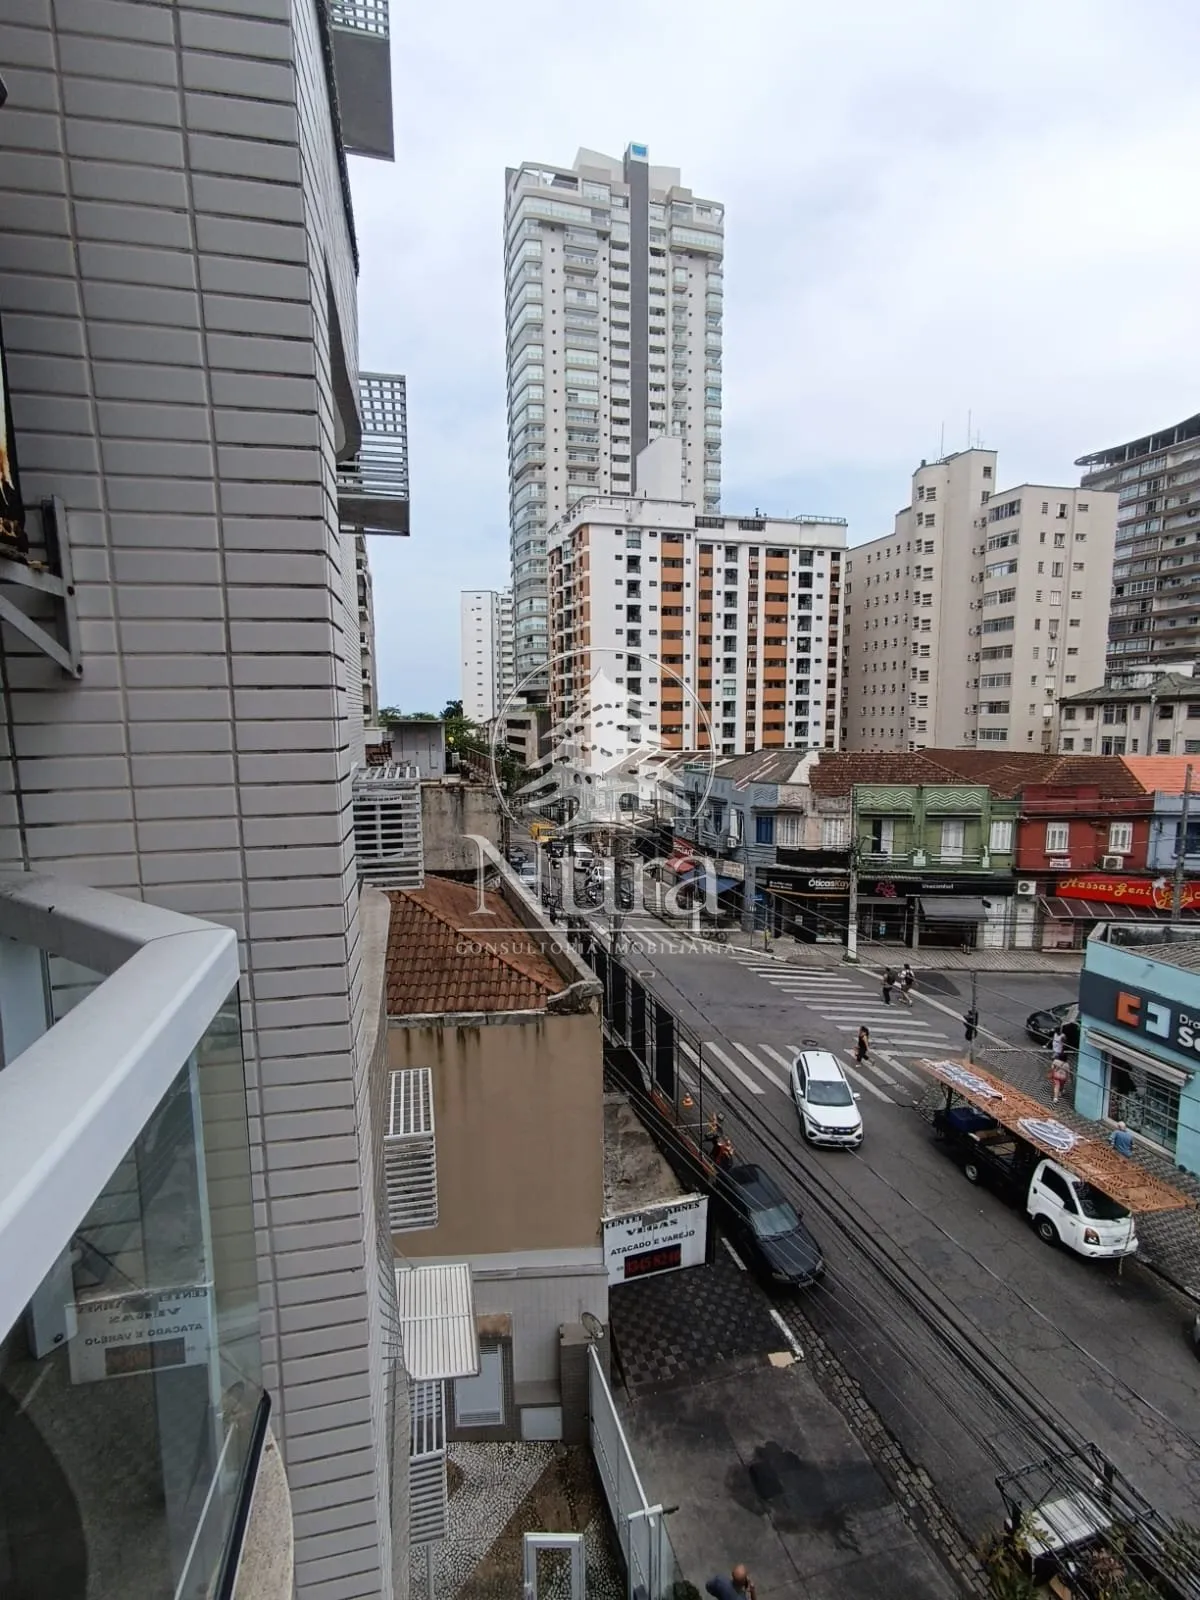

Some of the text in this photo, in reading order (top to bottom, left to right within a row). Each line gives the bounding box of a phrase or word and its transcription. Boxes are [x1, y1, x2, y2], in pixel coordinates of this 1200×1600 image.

[610, 1229, 696, 1256] ATACADO E VAREJO
